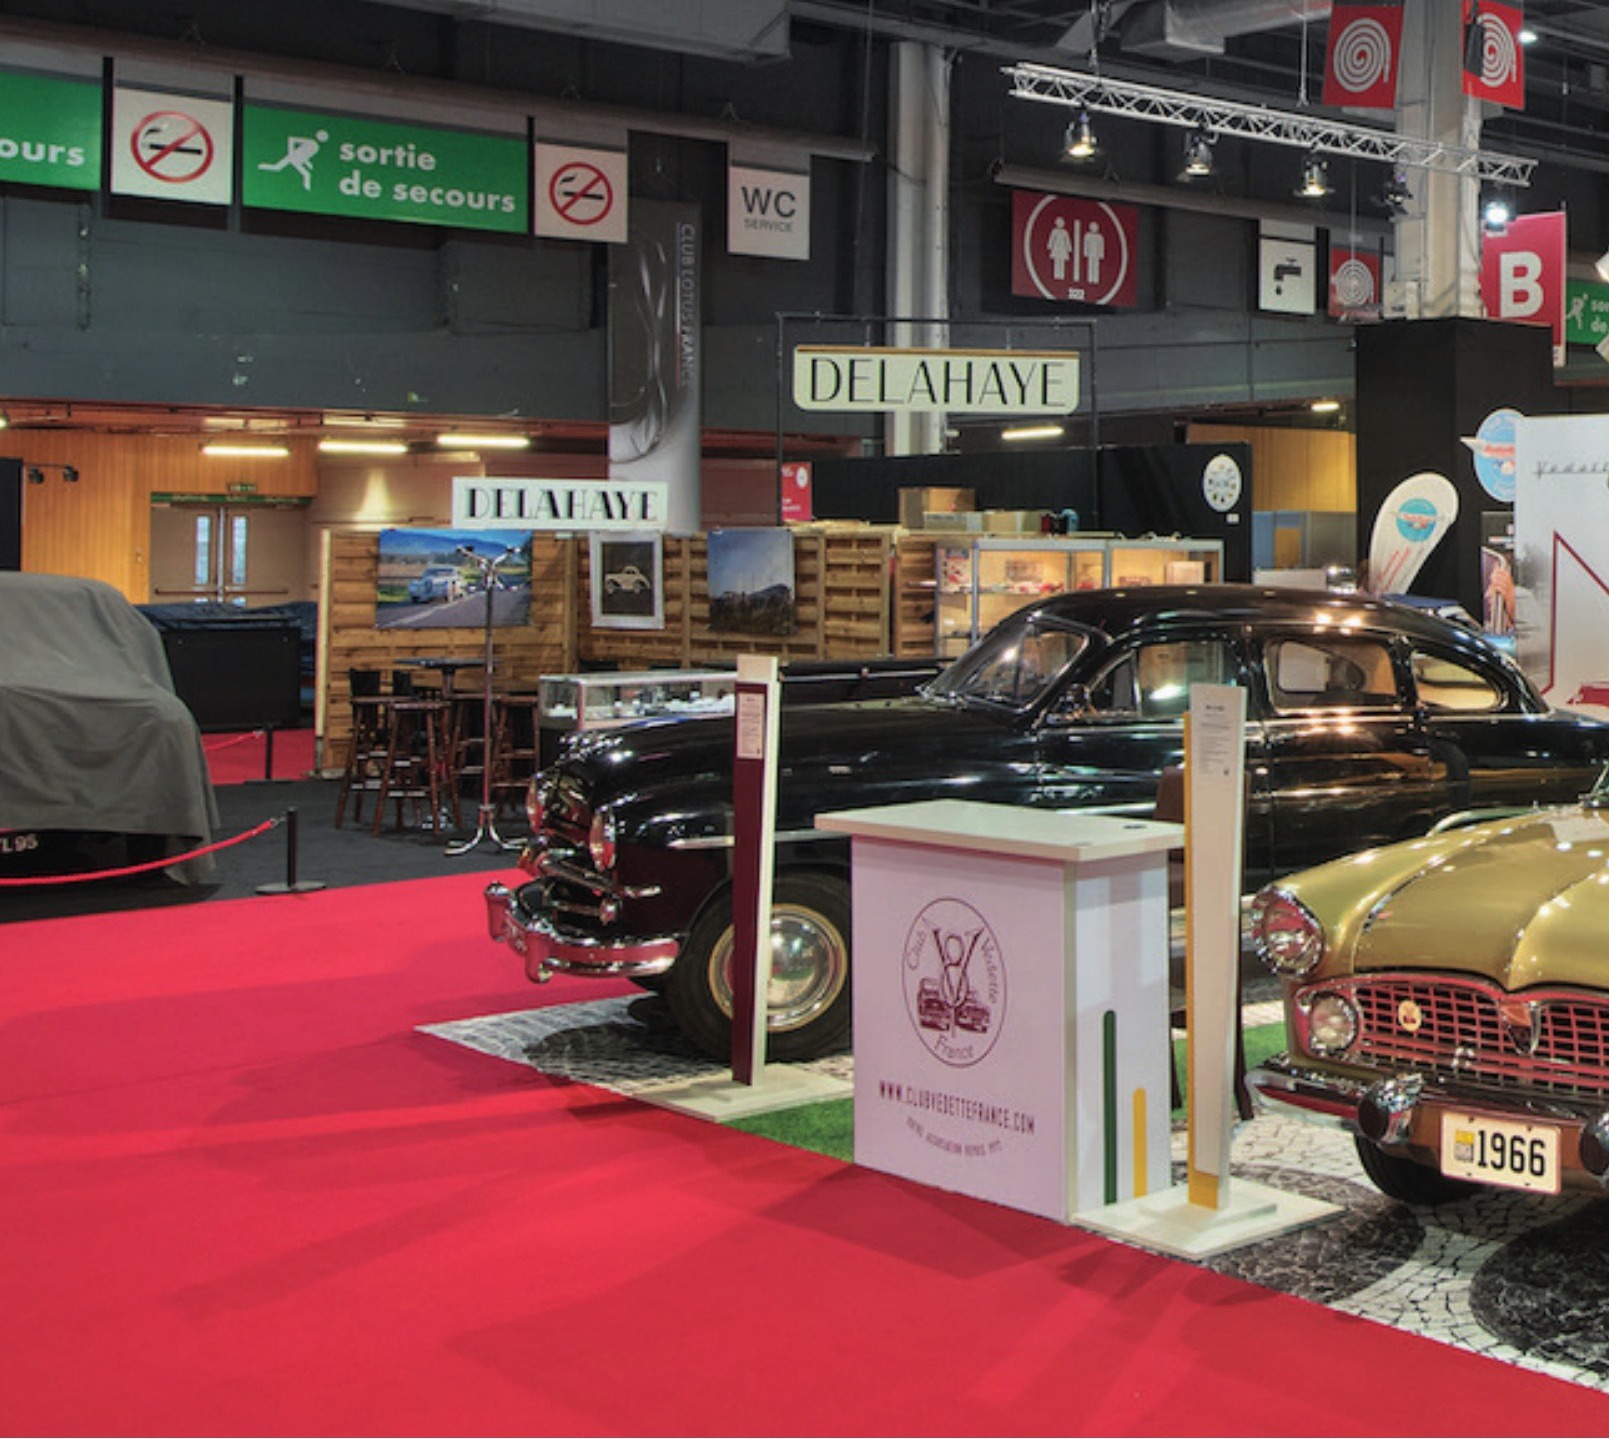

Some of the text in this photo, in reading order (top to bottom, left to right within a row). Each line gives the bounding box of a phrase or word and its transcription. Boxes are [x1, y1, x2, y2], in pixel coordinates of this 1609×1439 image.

[0, 138, 84, 166] ours
[339, 143, 436, 171] sortie
[339, 169, 516, 213] de secours
[741, 185, 796, 218] WC
[681, 224, 695, 265] CLUB
[744, 218, 793, 232] SERVICE
[1500, 251, 1543, 318] B
[810, 358, 1066, 407] DELAHAYE
[464, 487, 659, 522] DELAHAYE
[879, 1079, 1035, 1134] WWW.CLUBVEDETTEFRANCE.COM
[1477, 1130, 1546, 1177] 1966
